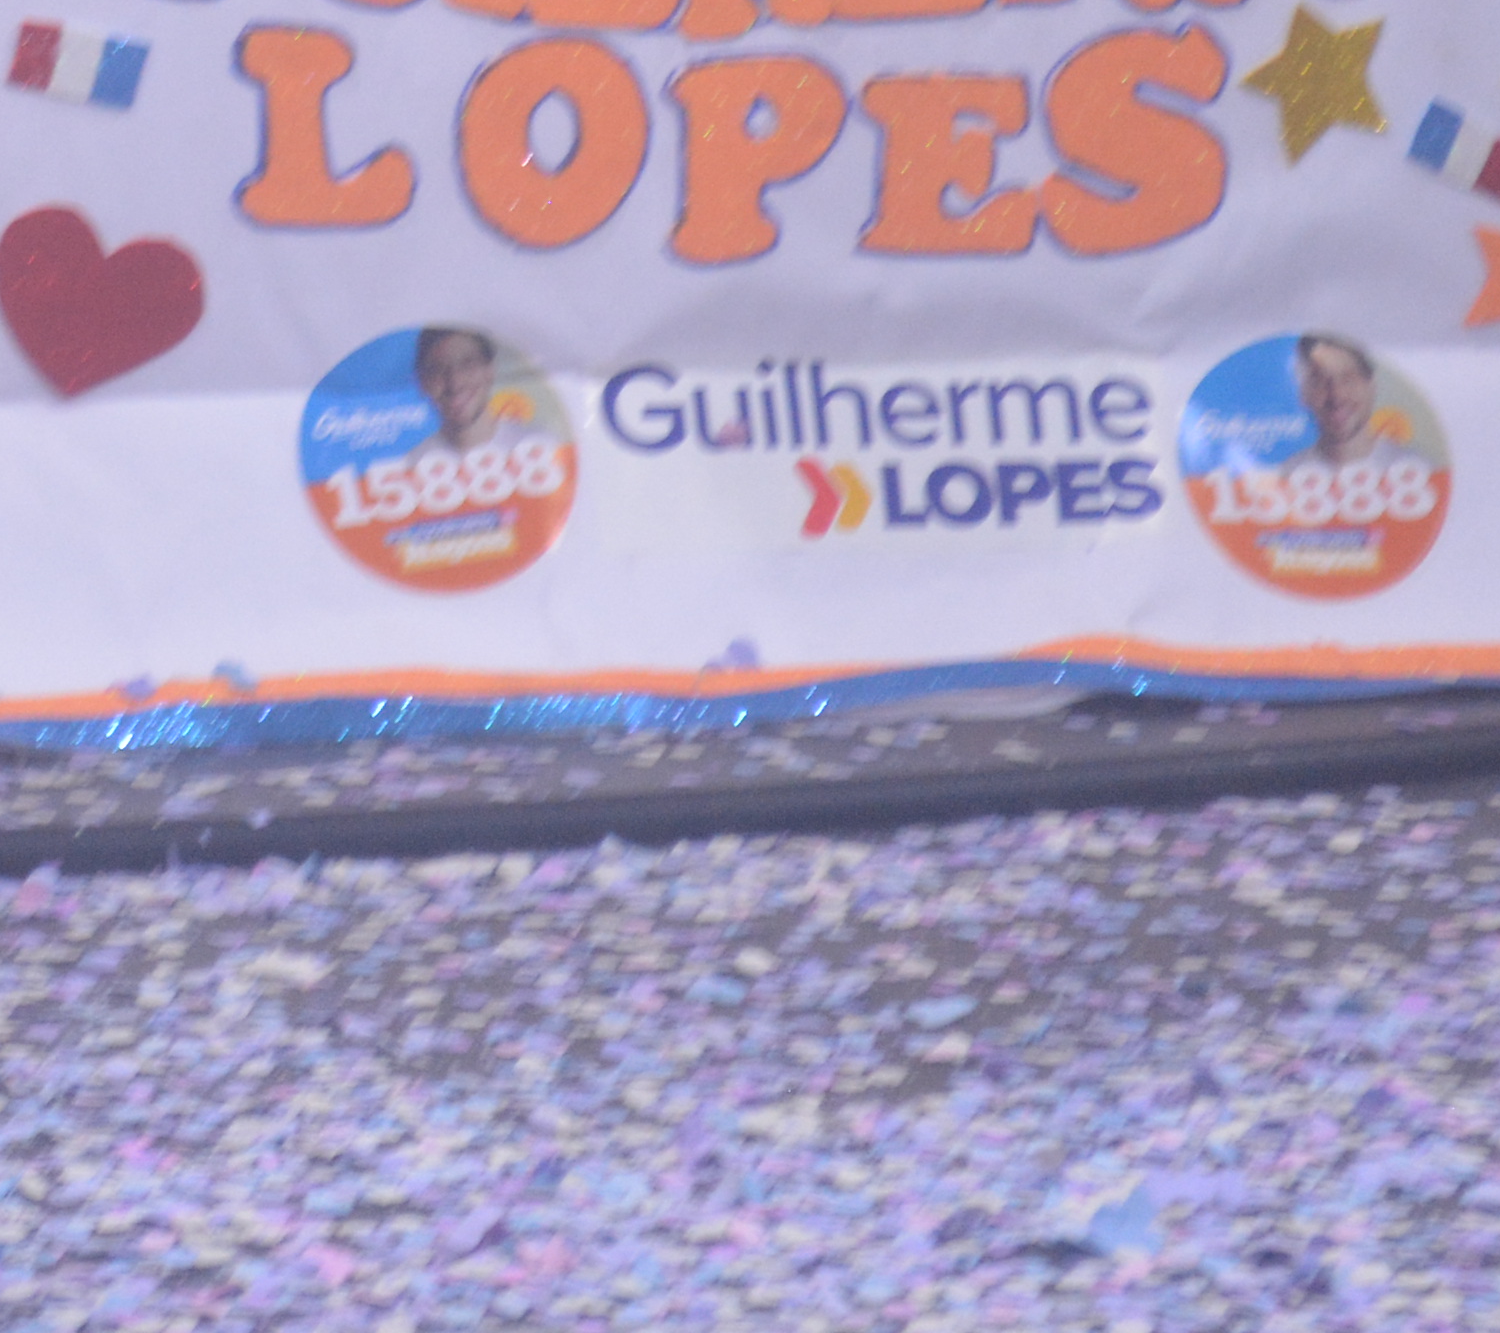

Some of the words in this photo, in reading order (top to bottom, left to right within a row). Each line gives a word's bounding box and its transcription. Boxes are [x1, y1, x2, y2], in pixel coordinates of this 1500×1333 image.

[233, 23, 1236, 267] LOPES
[602, 357, 1153, 454] Guilherme
[327, 437, 566, 530] 15888
[882, 458, 1166, 529] LOPES
[1203, 455, 1438, 525] 15888
